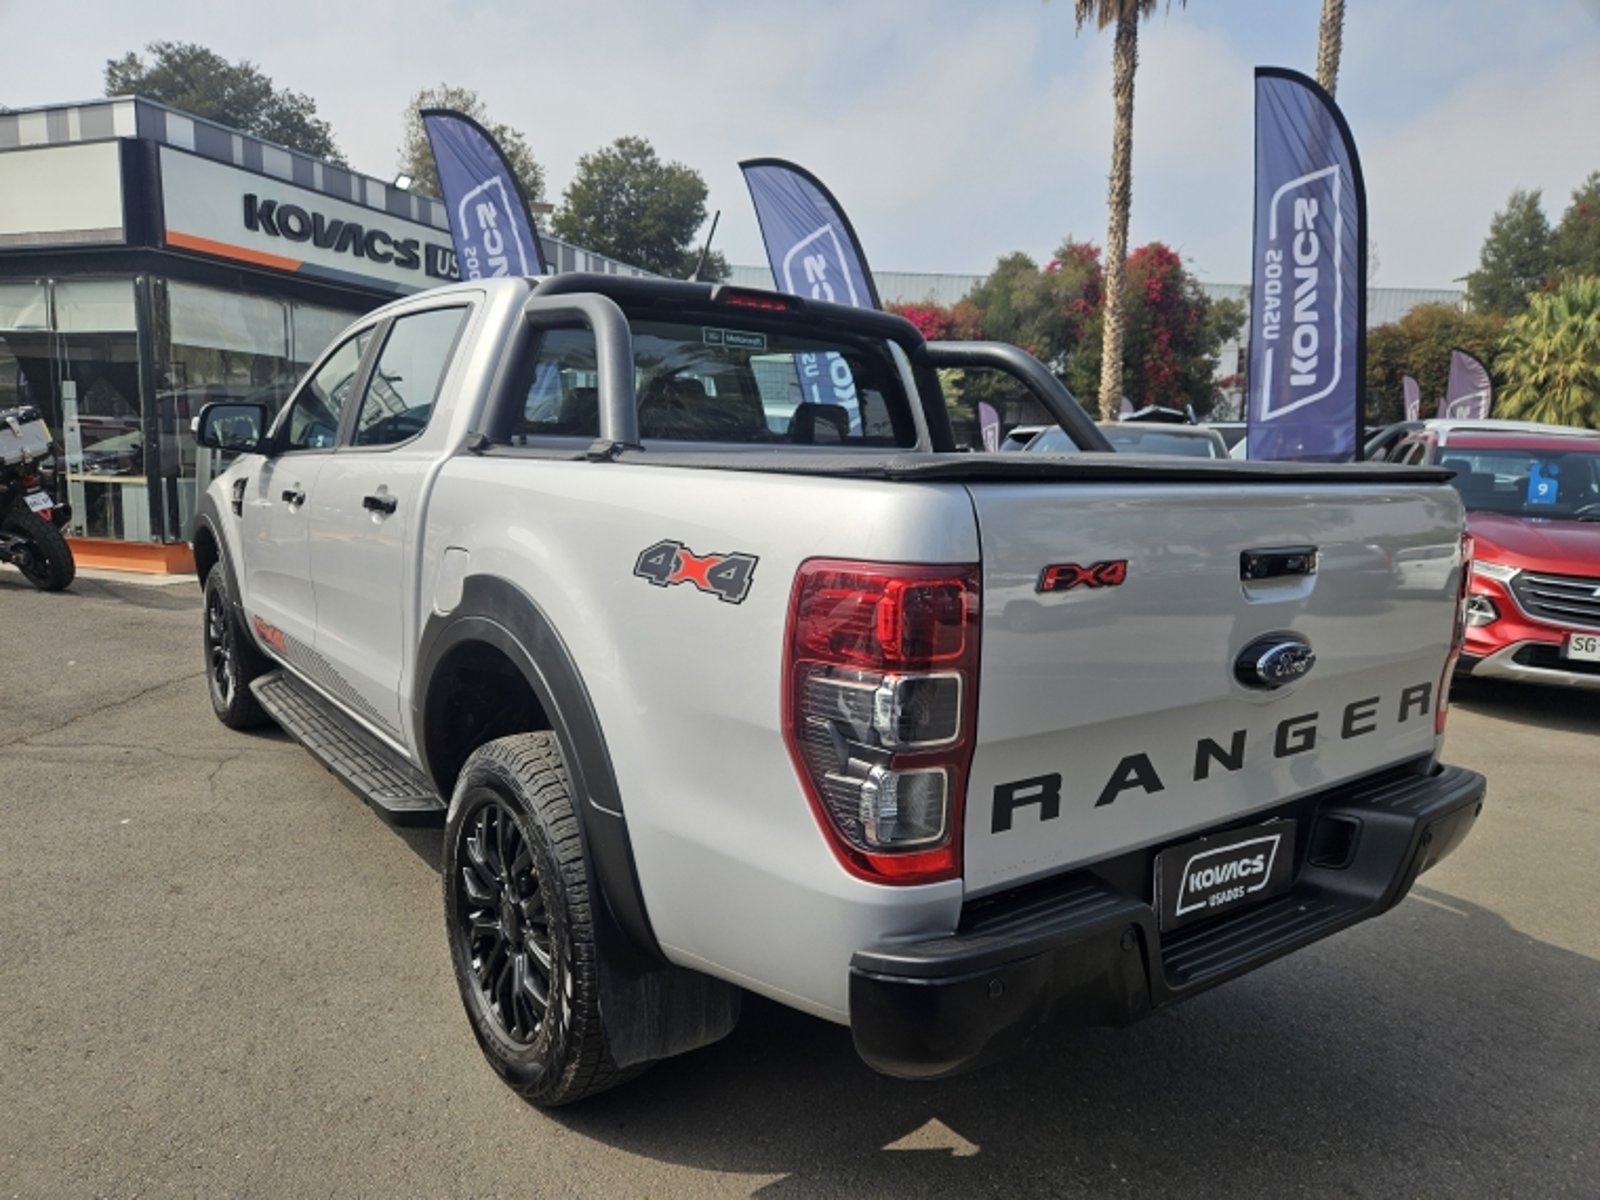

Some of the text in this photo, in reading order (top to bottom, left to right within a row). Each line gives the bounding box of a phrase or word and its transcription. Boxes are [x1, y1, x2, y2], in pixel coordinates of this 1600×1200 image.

[243, 193, 420, 270] KOVACS
[1538, 483, 1548, 495] 9
[1035, 560, 1128, 594] FX4
[991, 682, 1432, 834] RANGER
[1189, 854, 1265, 893] KOVACS
